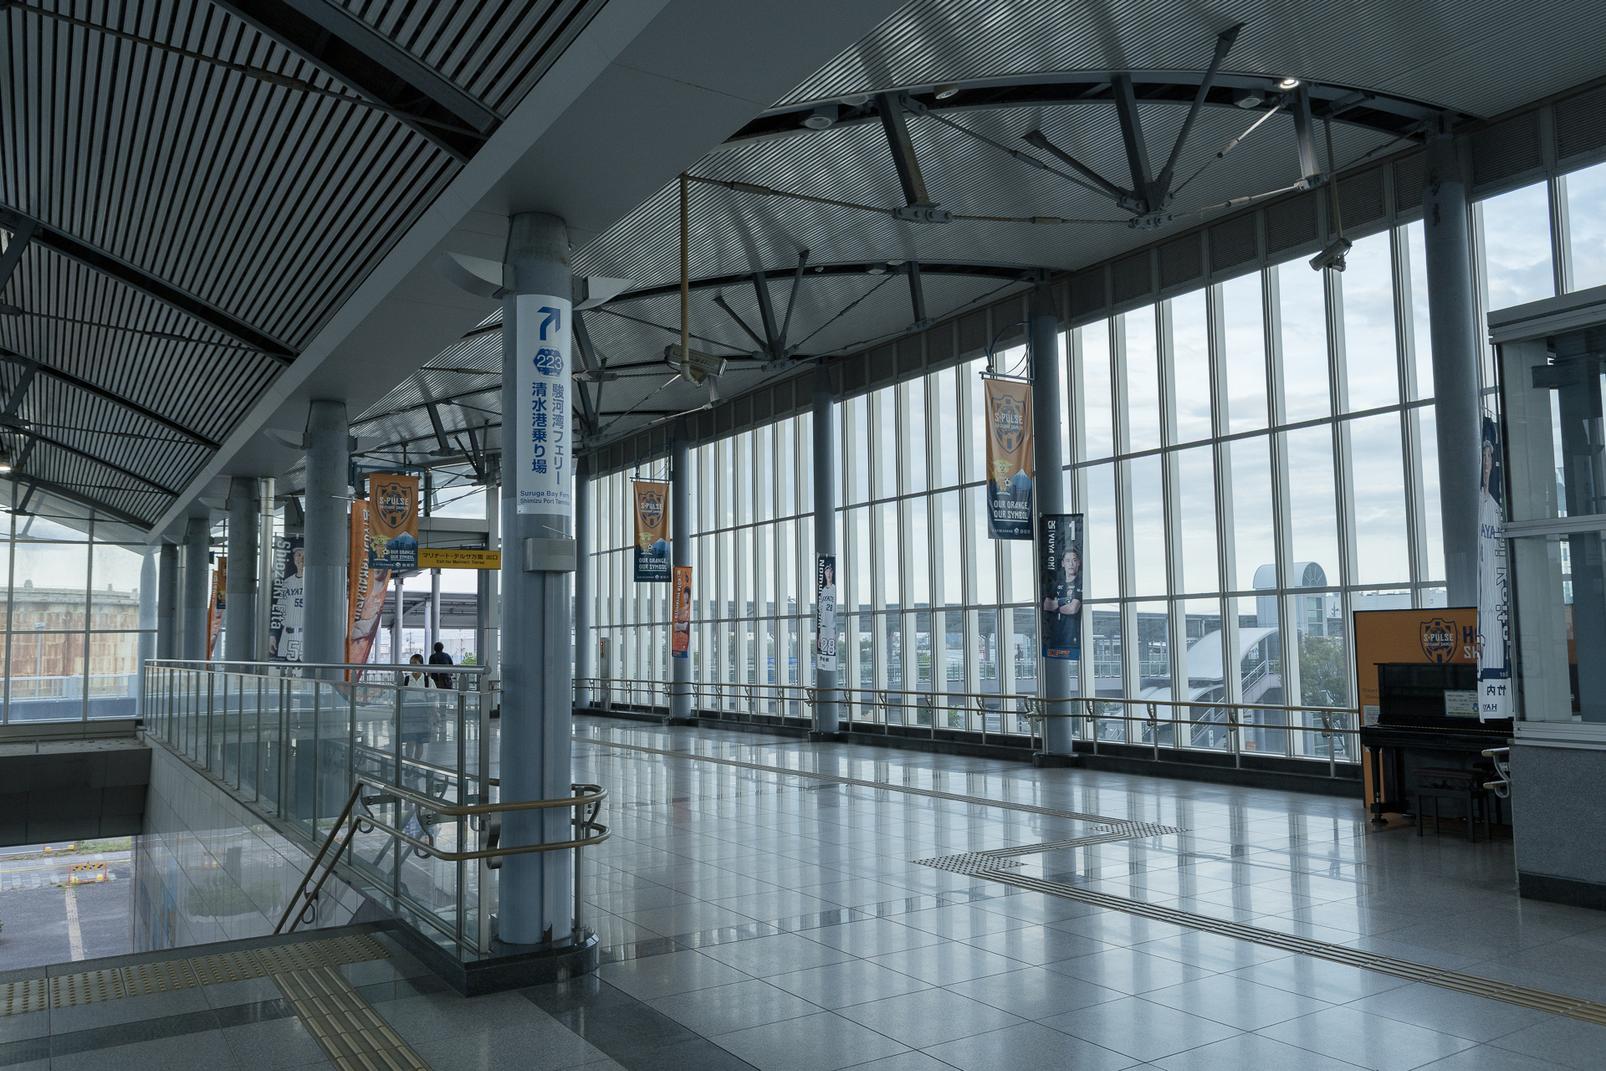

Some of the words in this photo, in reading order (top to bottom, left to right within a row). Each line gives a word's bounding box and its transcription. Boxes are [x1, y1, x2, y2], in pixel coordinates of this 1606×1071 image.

[536, 353, 562, 371] 223
[531, 382, 548, 474] 清水港乗り場
[552, 383, 565, 485] 駿河湾フェリー
[520, 490, 544, 498] Suruga
[993, 499, 1006, 509] OUR
[993, 509, 1006, 519] OUR
[1069, 520, 1076, 541] 1
[1048, 533, 1056, 554] YUYA
[272, 540, 291, 600] Shiozaki
[1047, 556, 1056, 570] OKI
[270, 604, 285, 630] Eita
[821, 638, 835, 656] 28
